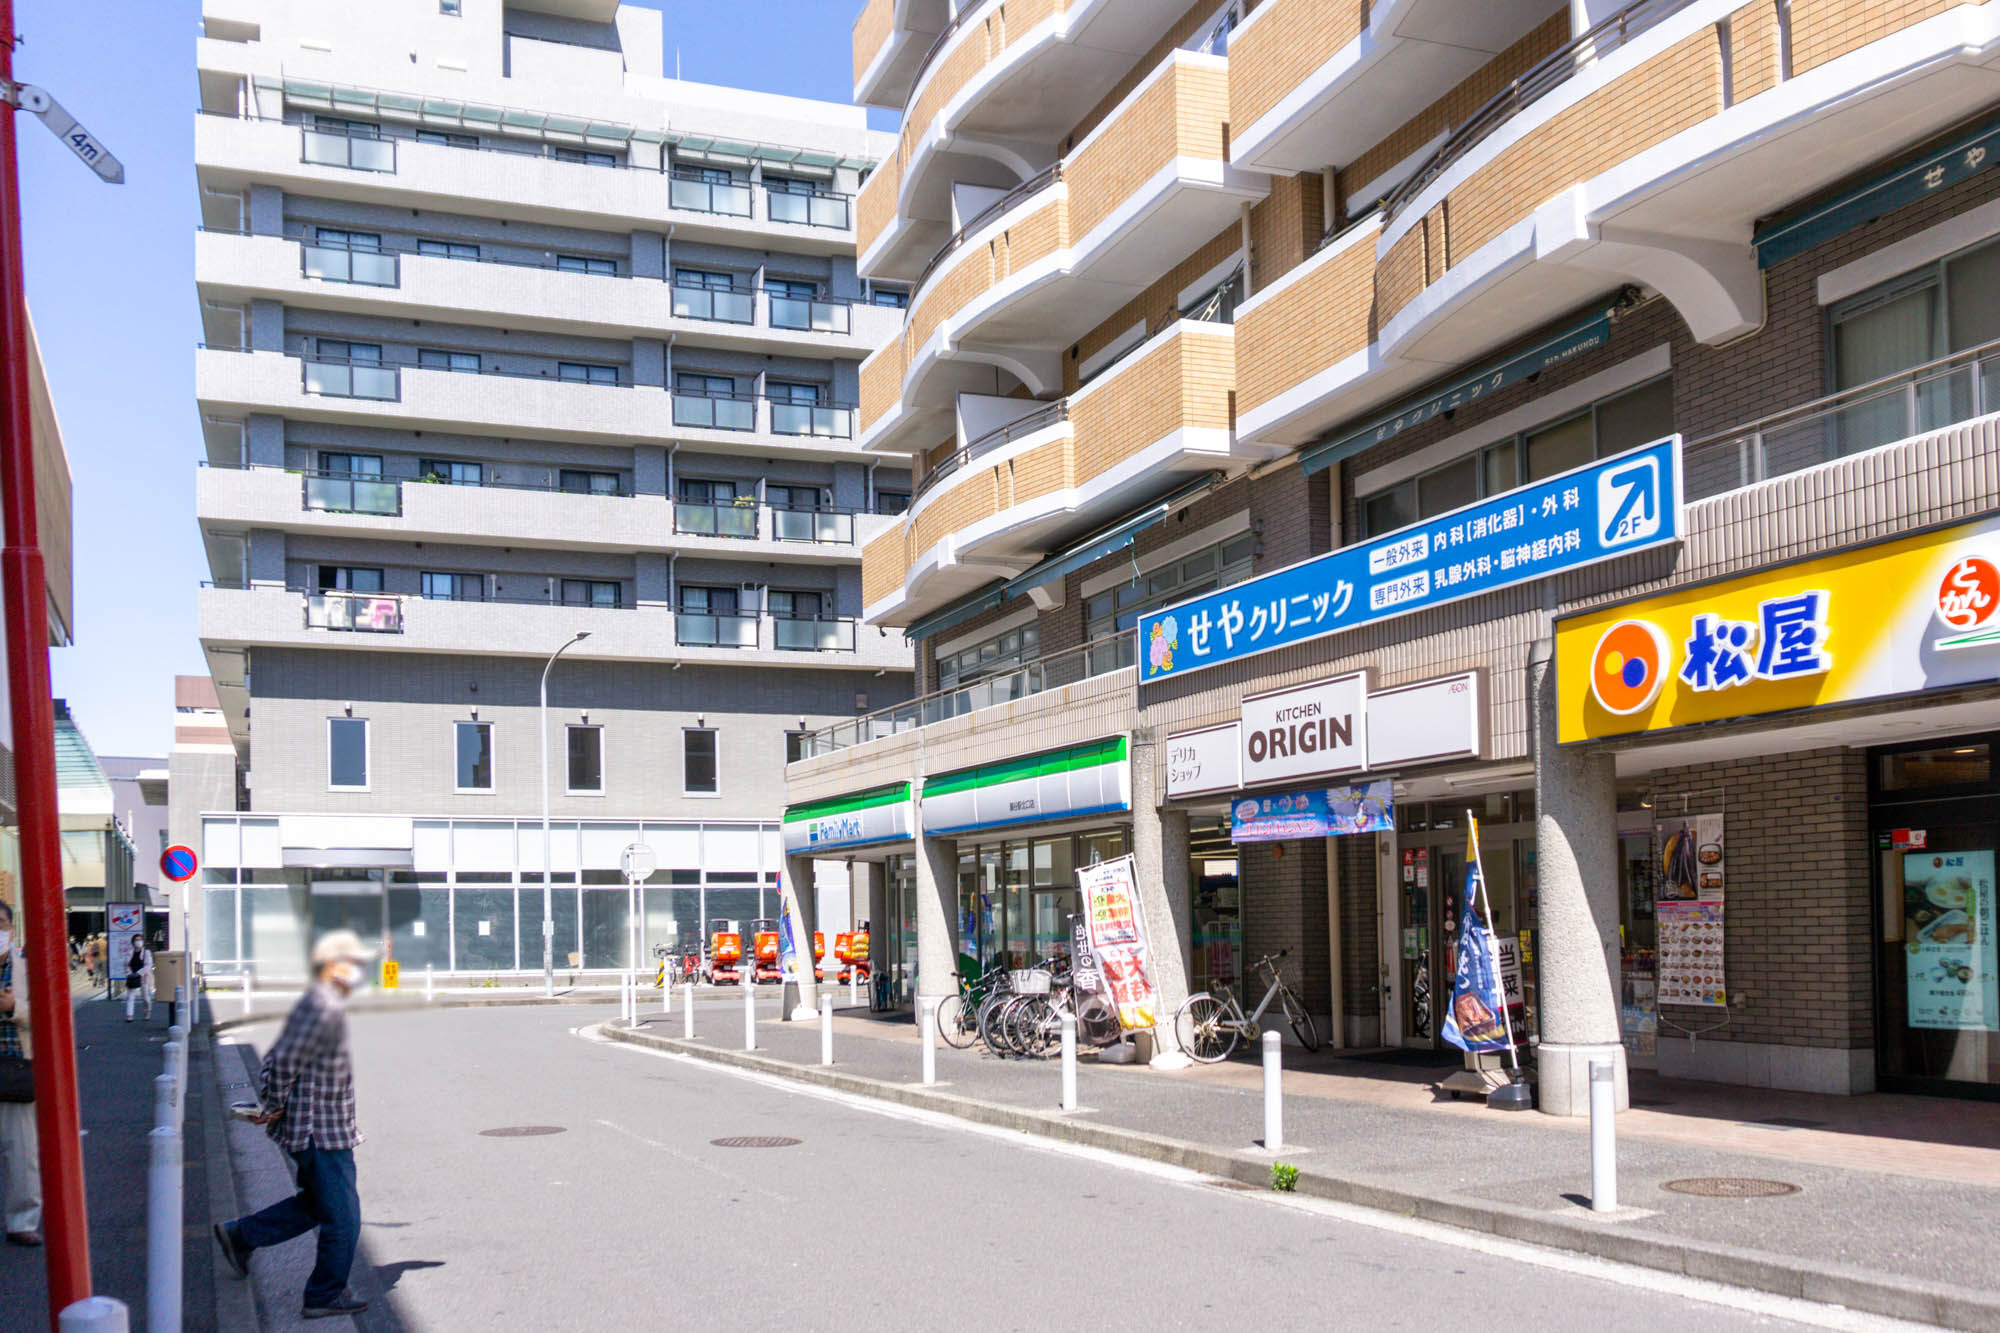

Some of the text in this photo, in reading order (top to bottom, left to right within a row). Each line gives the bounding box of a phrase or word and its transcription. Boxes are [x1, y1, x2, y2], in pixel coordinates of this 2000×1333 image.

[71, 134, 97, 160] 4m
[1924, 146, 1986, 189] せや
[1376, 372, 1503, 441] せやクリニック
[1618, 516, 1642, 539] 2F
[1373, 538, 1425, 567] 一般外来
[1374, 527, 1581, 606] 専門外来 乳腺外科・脳神経内科
[1187, 579, 1354, 656] せやクリニック
[1682, 592, 1821, 690] 松屋
[1275, 701, 1322, 723] KITCHEN
[1248, 713, 1353, 763] ORIGIN
[1170, 746, 1196, 764] デリカ
[1170, 763, 1202, 783] ショップ
[819, 816, 862, 842] FamilyMart
